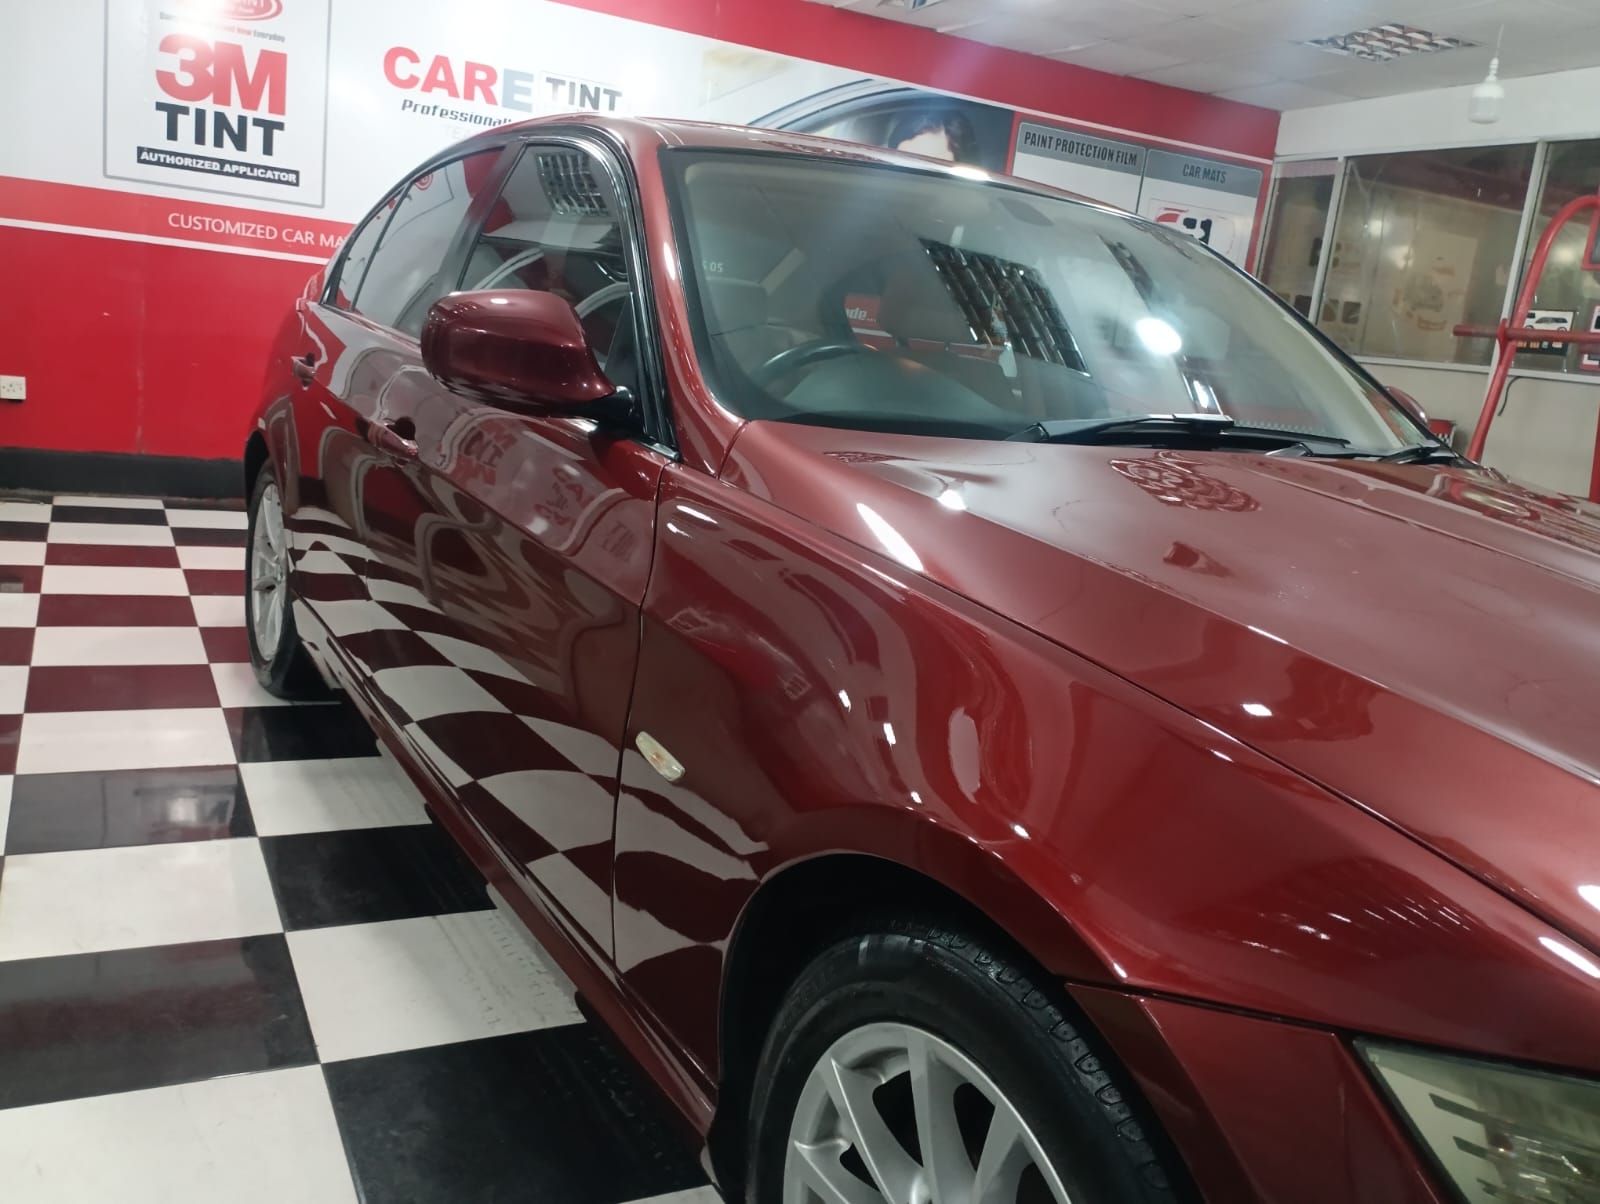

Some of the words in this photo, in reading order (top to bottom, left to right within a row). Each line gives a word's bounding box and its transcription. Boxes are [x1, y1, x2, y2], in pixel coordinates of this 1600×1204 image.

[155, 33, 288, 116] 3M
[383, 46, 535, 113] CARE
[545, 76, 623, 112] TINT
[155, 101, 285, 156] TINT
[140, 150, 221, 171] AUTHORIZED
[223, 163, 297, 183] APPLICATOR
[1024, 131, 1054, 149] PAINT
[1055, 138, 1115, 163] PROTECTION
[1115, 151, 1138, 167] FILM
[1182, 163, 1202, 178] CAR
[1202, 167, 1227, 184] MATS
[168, 213, 278, 241] CUSTOMIZED
[282, 228, 315, 245] CAR
[319, 232, 347, 248] MA
